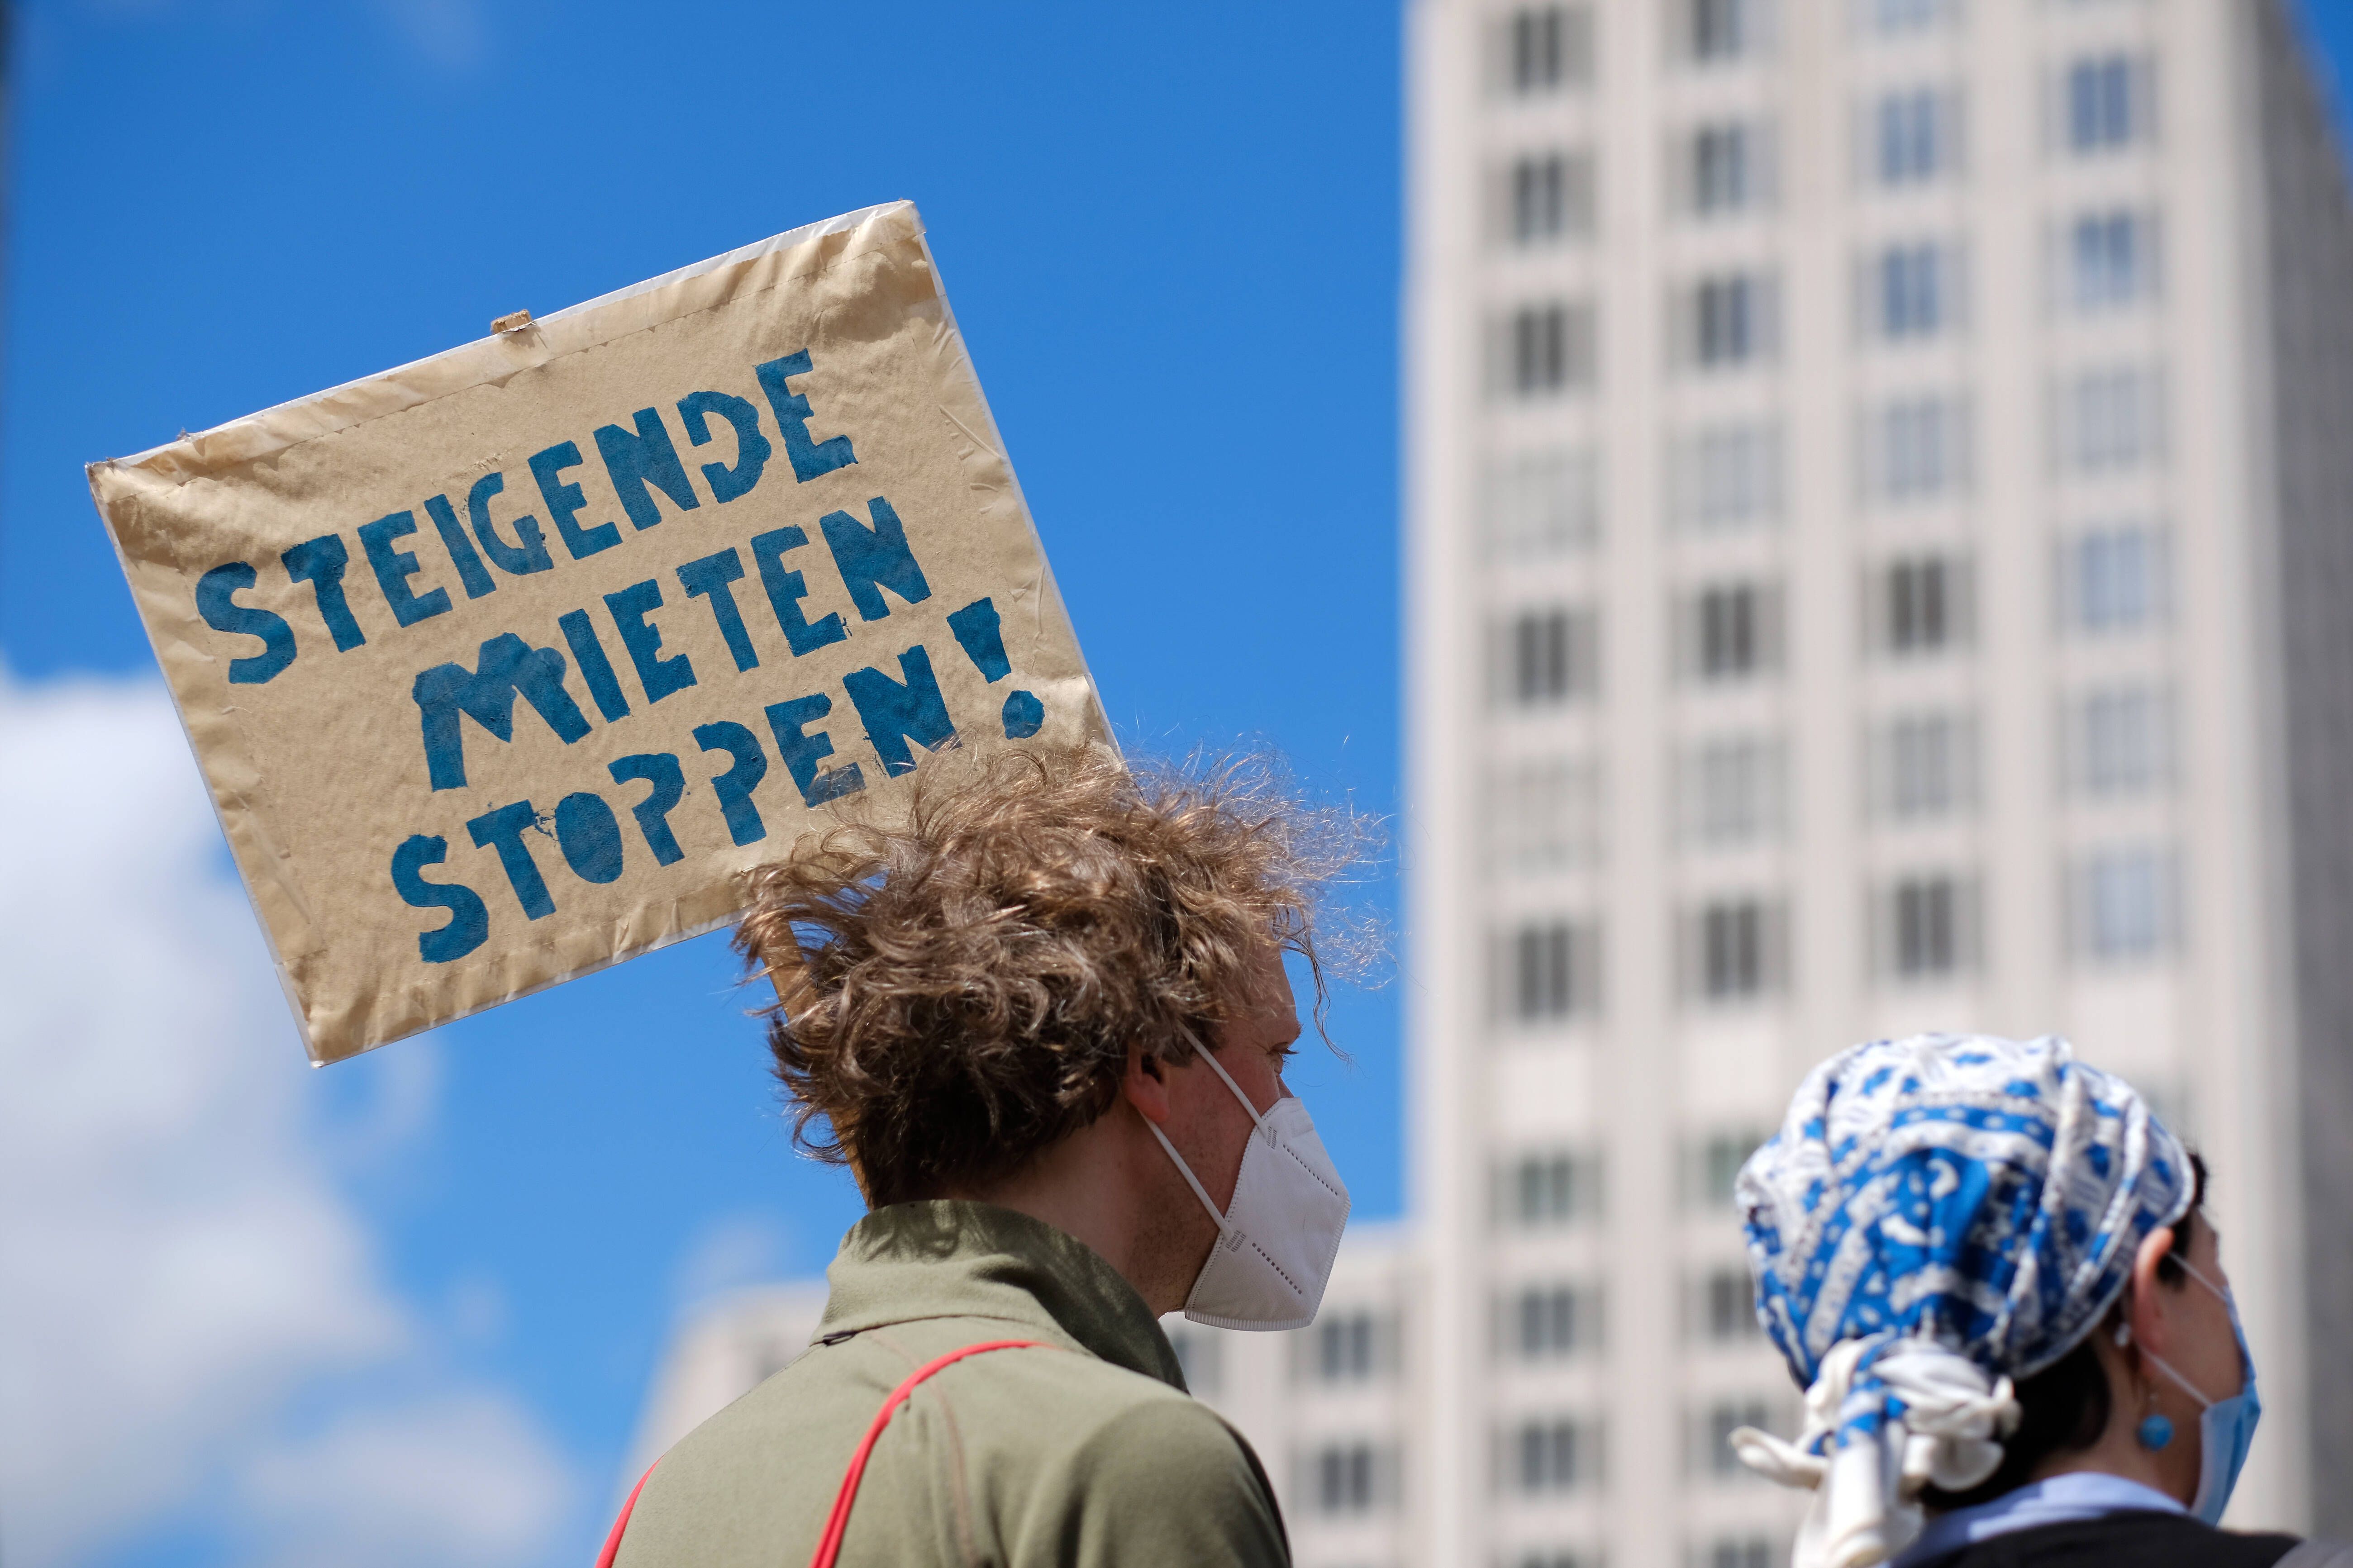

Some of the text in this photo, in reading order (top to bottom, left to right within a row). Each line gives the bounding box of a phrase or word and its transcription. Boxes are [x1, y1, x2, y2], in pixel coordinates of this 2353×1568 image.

[196, 349, 857, 684] STEIGENDE
[413, 496, 931, 791] MIETEN
[391, 597, 1045, 963] STOPPEN!
